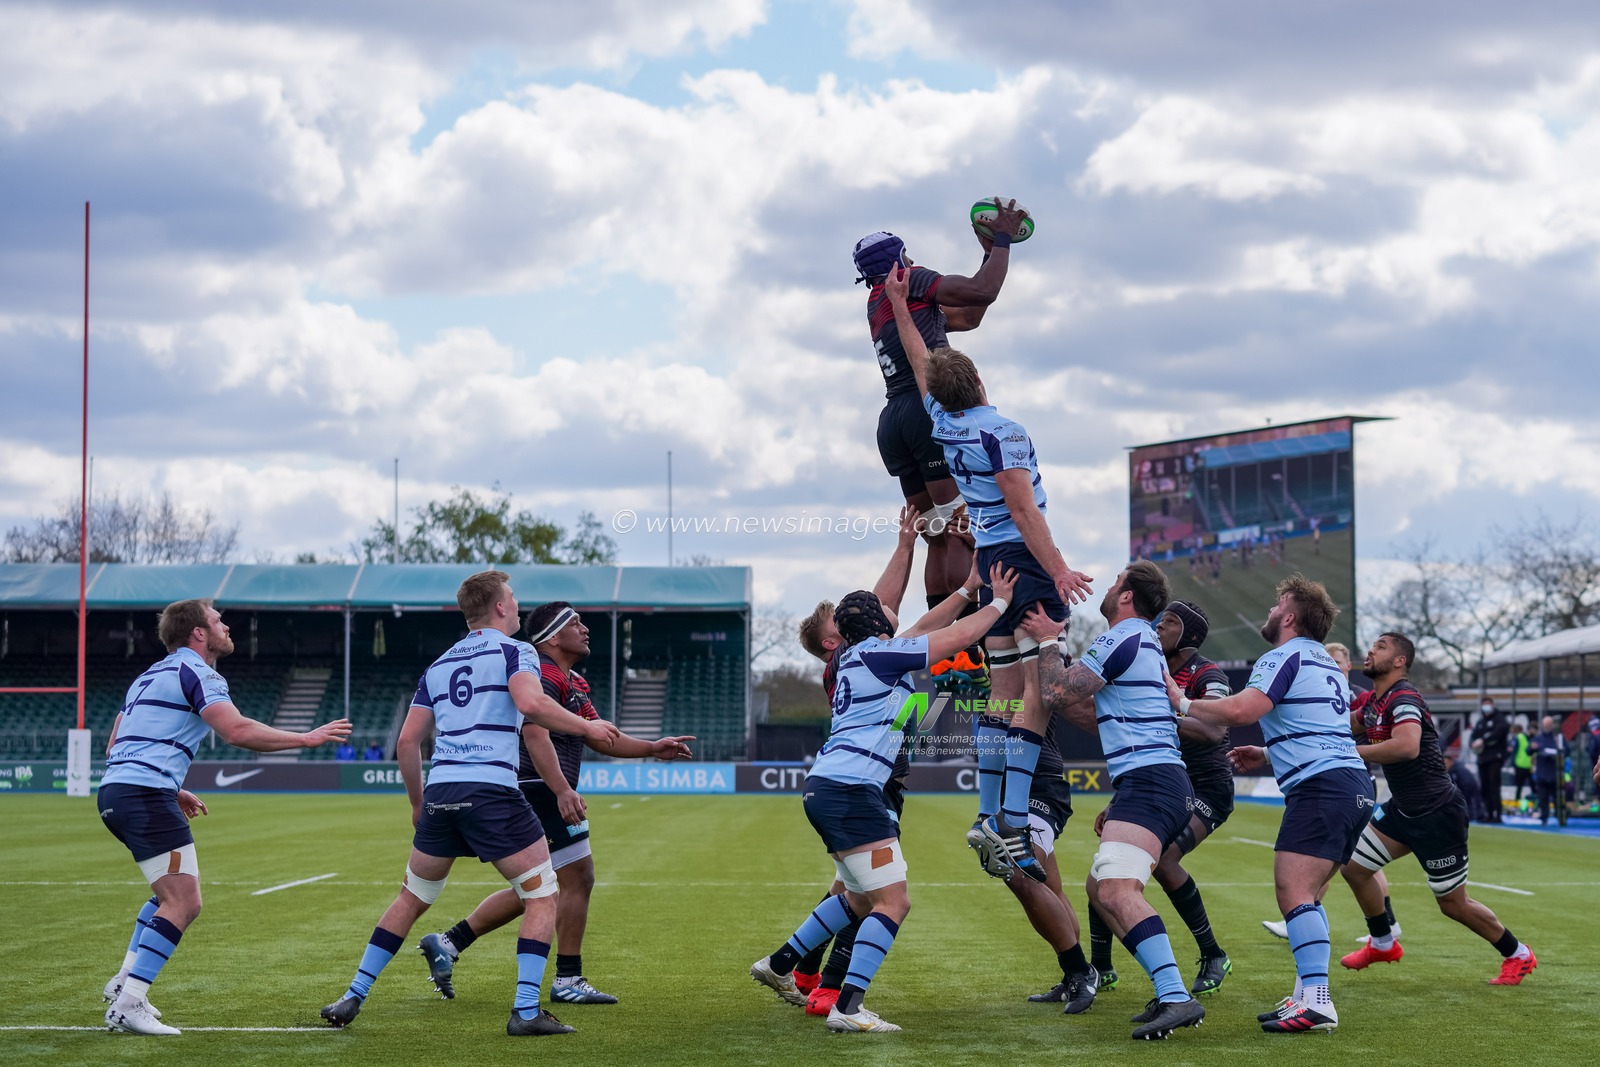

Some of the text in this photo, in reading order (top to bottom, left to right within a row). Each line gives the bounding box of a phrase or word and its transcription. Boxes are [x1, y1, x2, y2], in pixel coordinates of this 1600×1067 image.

[928, 460, 942, 468] CITY
[954, 449, 973, 485] 4
[127, 678, 155, 716] 7
[449, 665, 474, 708] 6
[831, 675, 852, 718] 0
[1326, 675, 1347, 716] 3
[0, 765, 33, 779] NG IPA
[578, 769, 628, 788] MBA
[648, 769, 726, 788] SIMBA
[956, 768, 980, 790] CI
